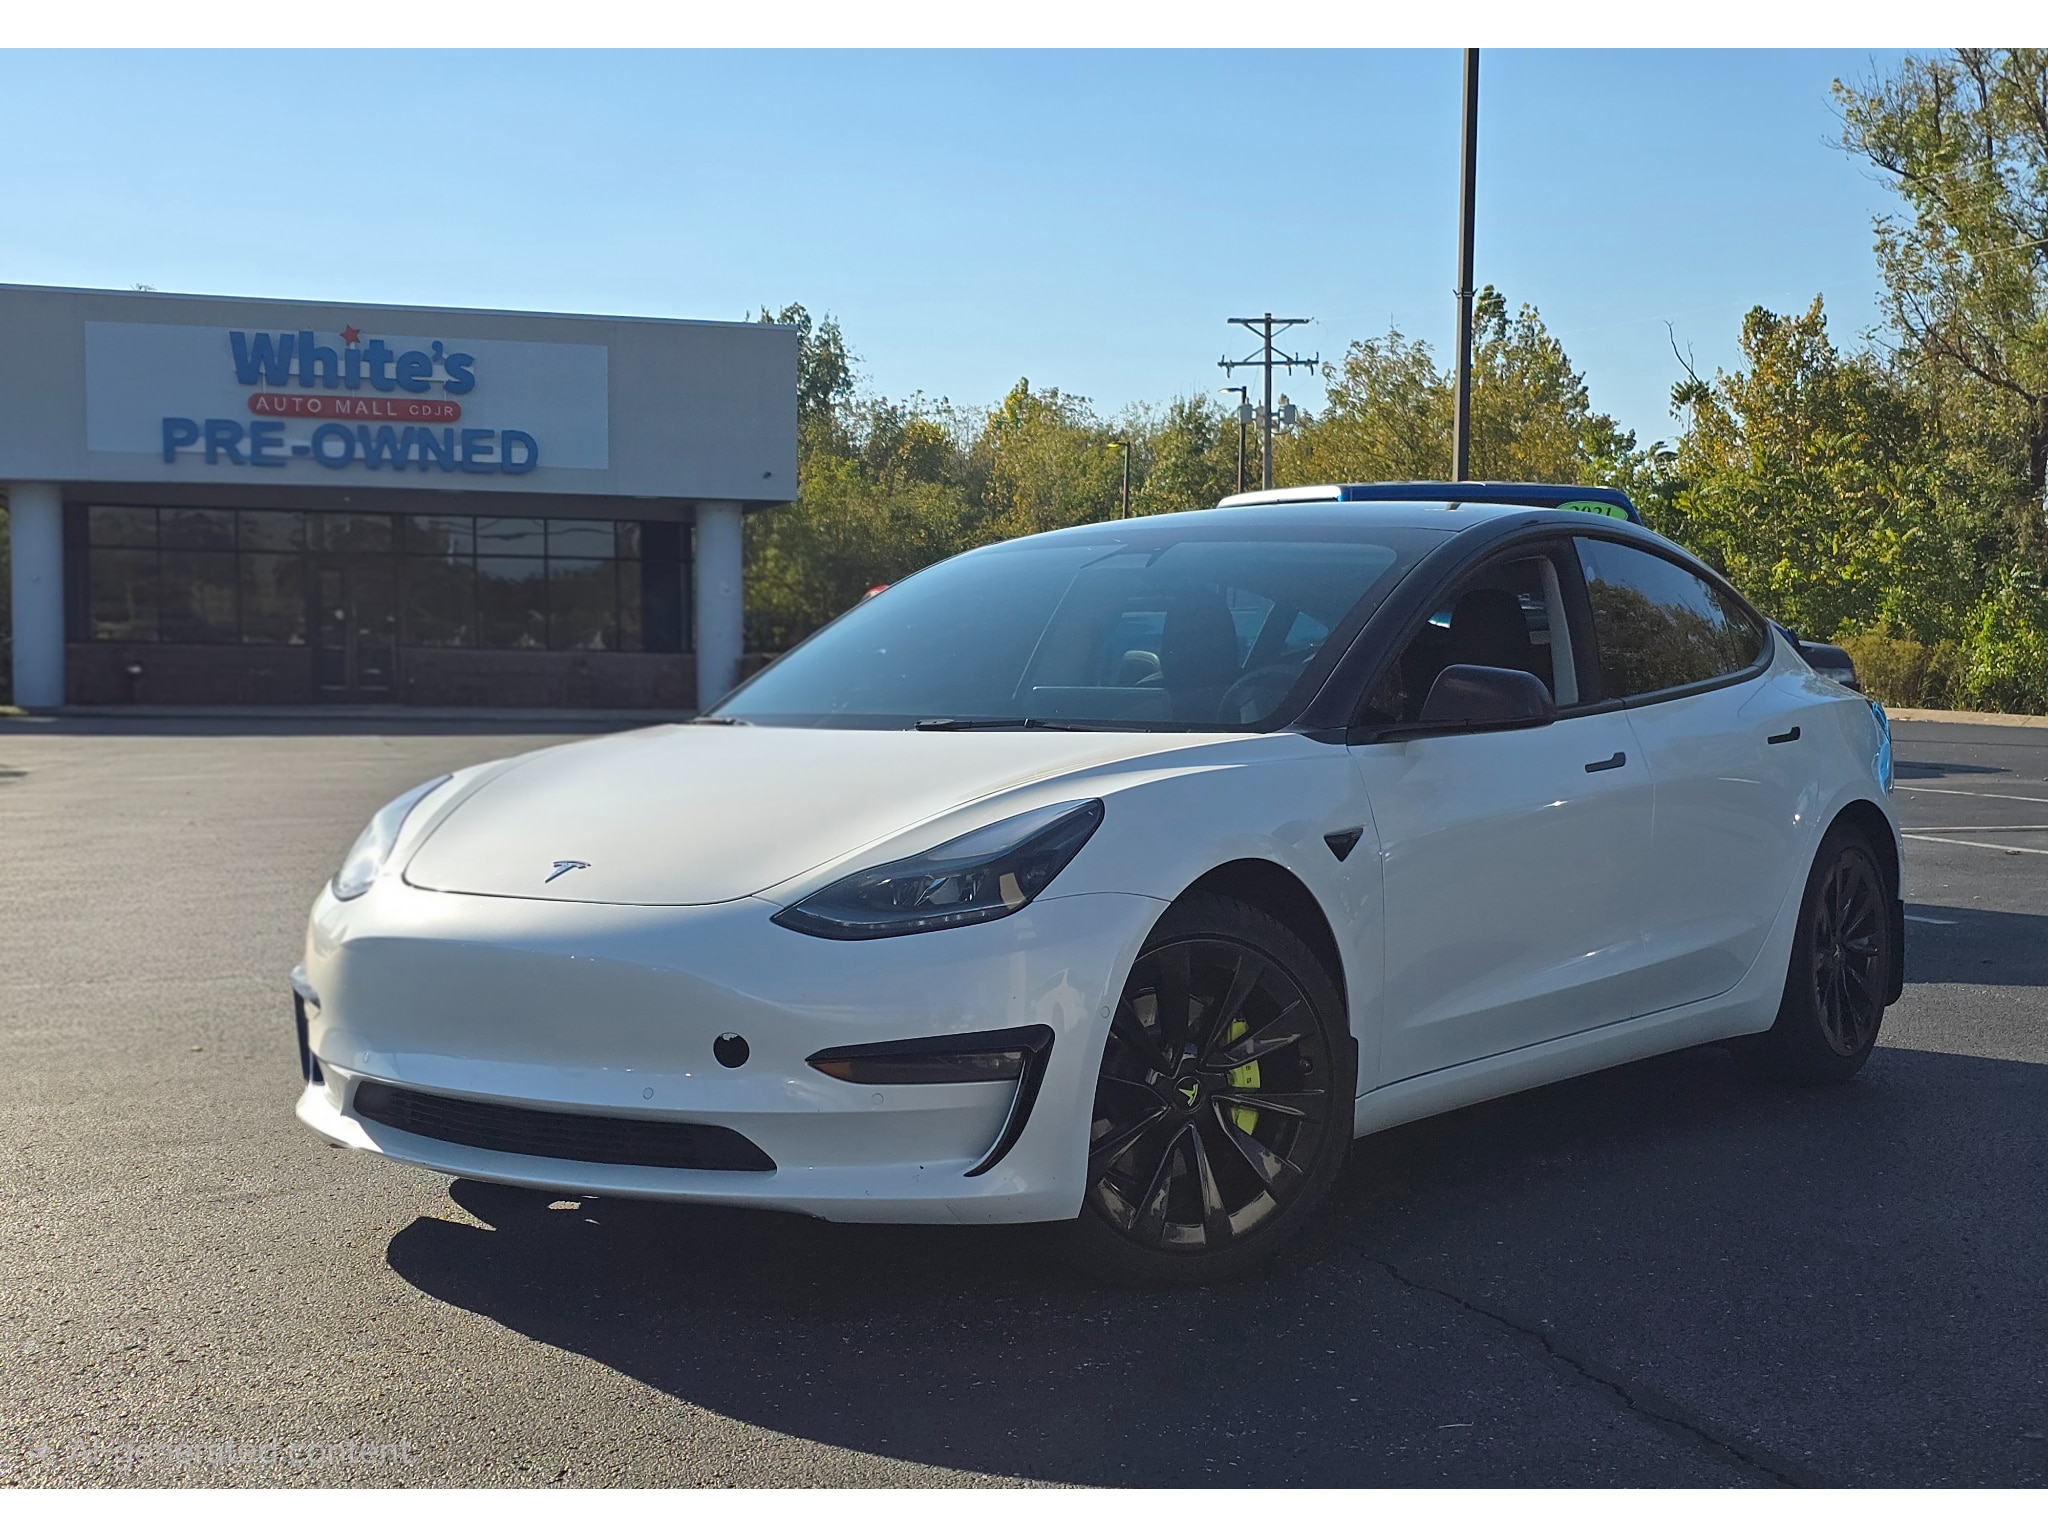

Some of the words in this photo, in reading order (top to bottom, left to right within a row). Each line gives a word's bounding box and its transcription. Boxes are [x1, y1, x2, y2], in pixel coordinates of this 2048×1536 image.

[229, 326, 476, 395] White's
[255, 397, 322, 414] AUTO
[335, 399, 398, 417] MALL
[408, 404, 455, 418] CDJR
[161, 417, 539, 475] PRE-OWNED
